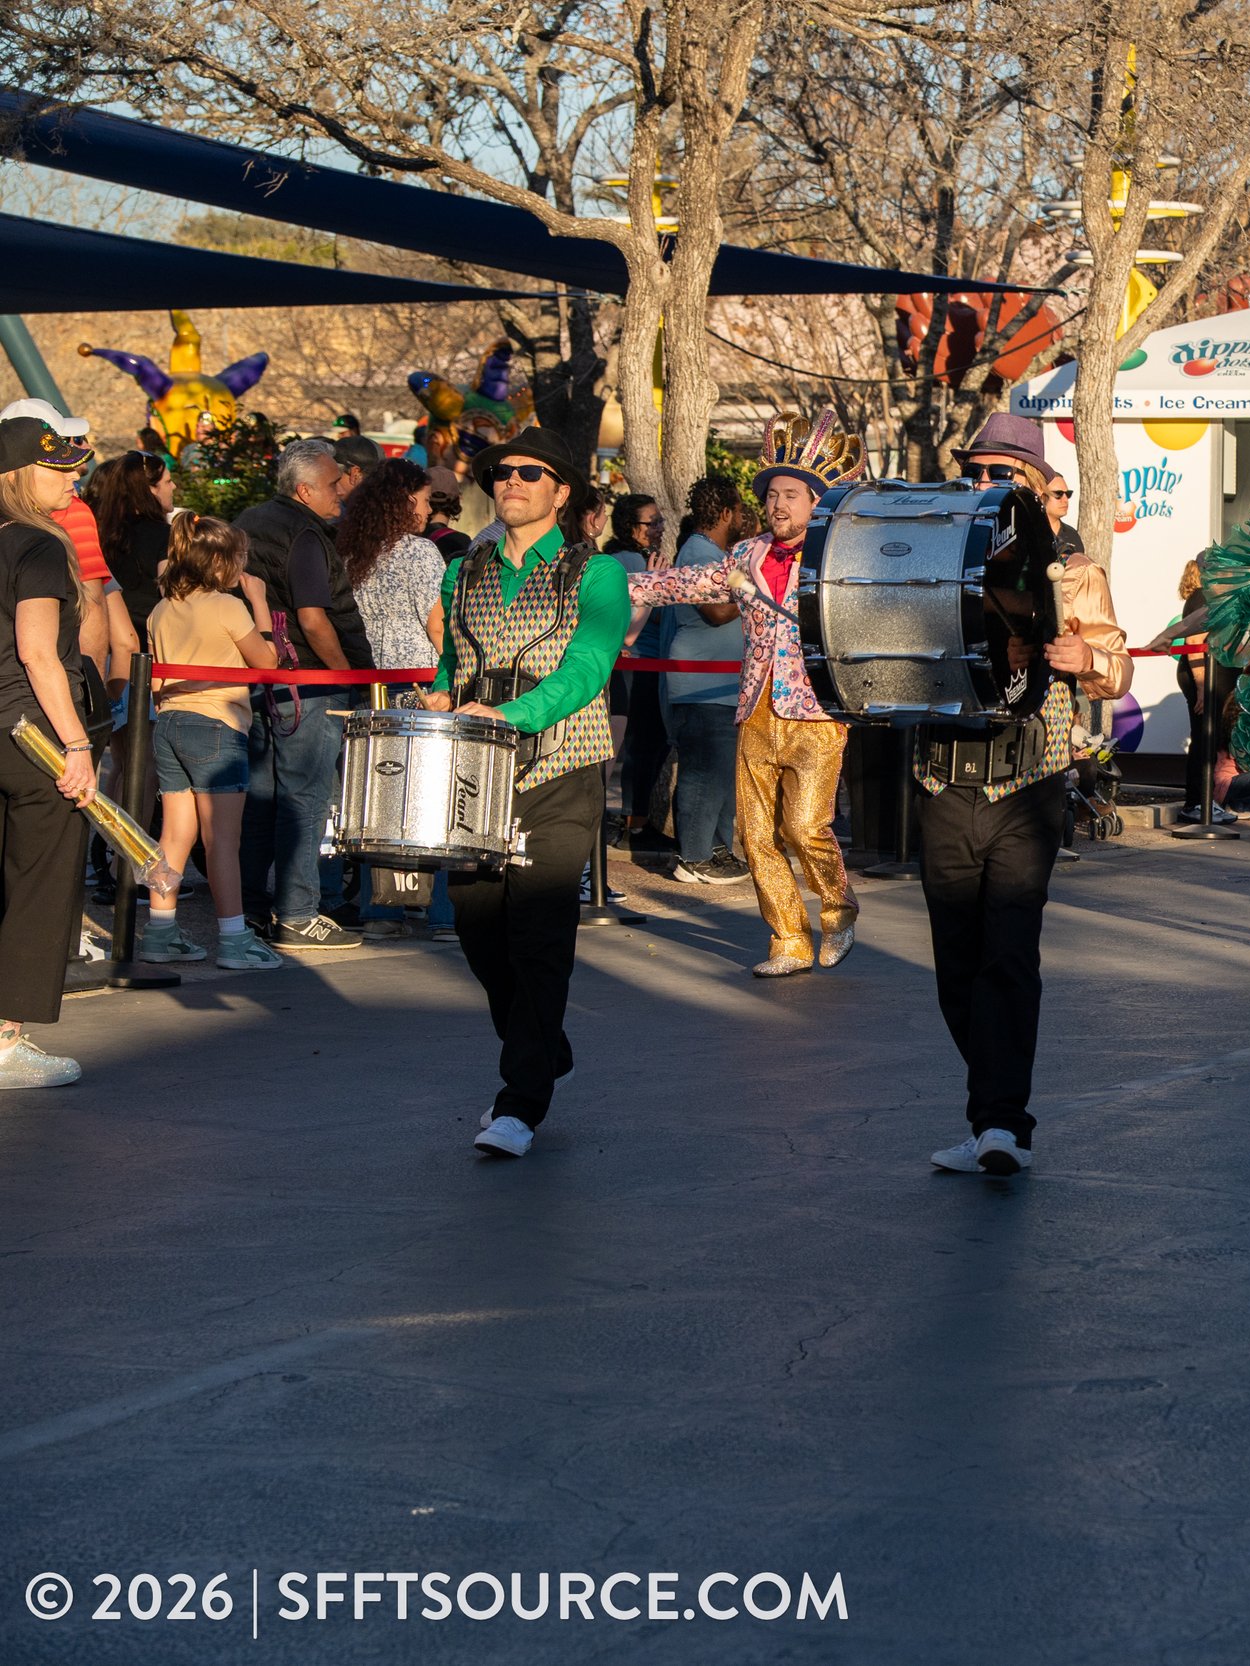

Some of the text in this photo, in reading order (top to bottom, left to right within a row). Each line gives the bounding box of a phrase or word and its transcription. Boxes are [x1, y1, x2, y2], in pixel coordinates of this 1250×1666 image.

[1160, 395, 1185, 409] Ice
[1117, 456, 1182, 503] ppin'
[1135, 499, 1173, 519] dots
[987, 505, 1017, 560] Pearl
[1009, 679, 1026, 699] REMO
[456, 765, 480, 834] Pearl
